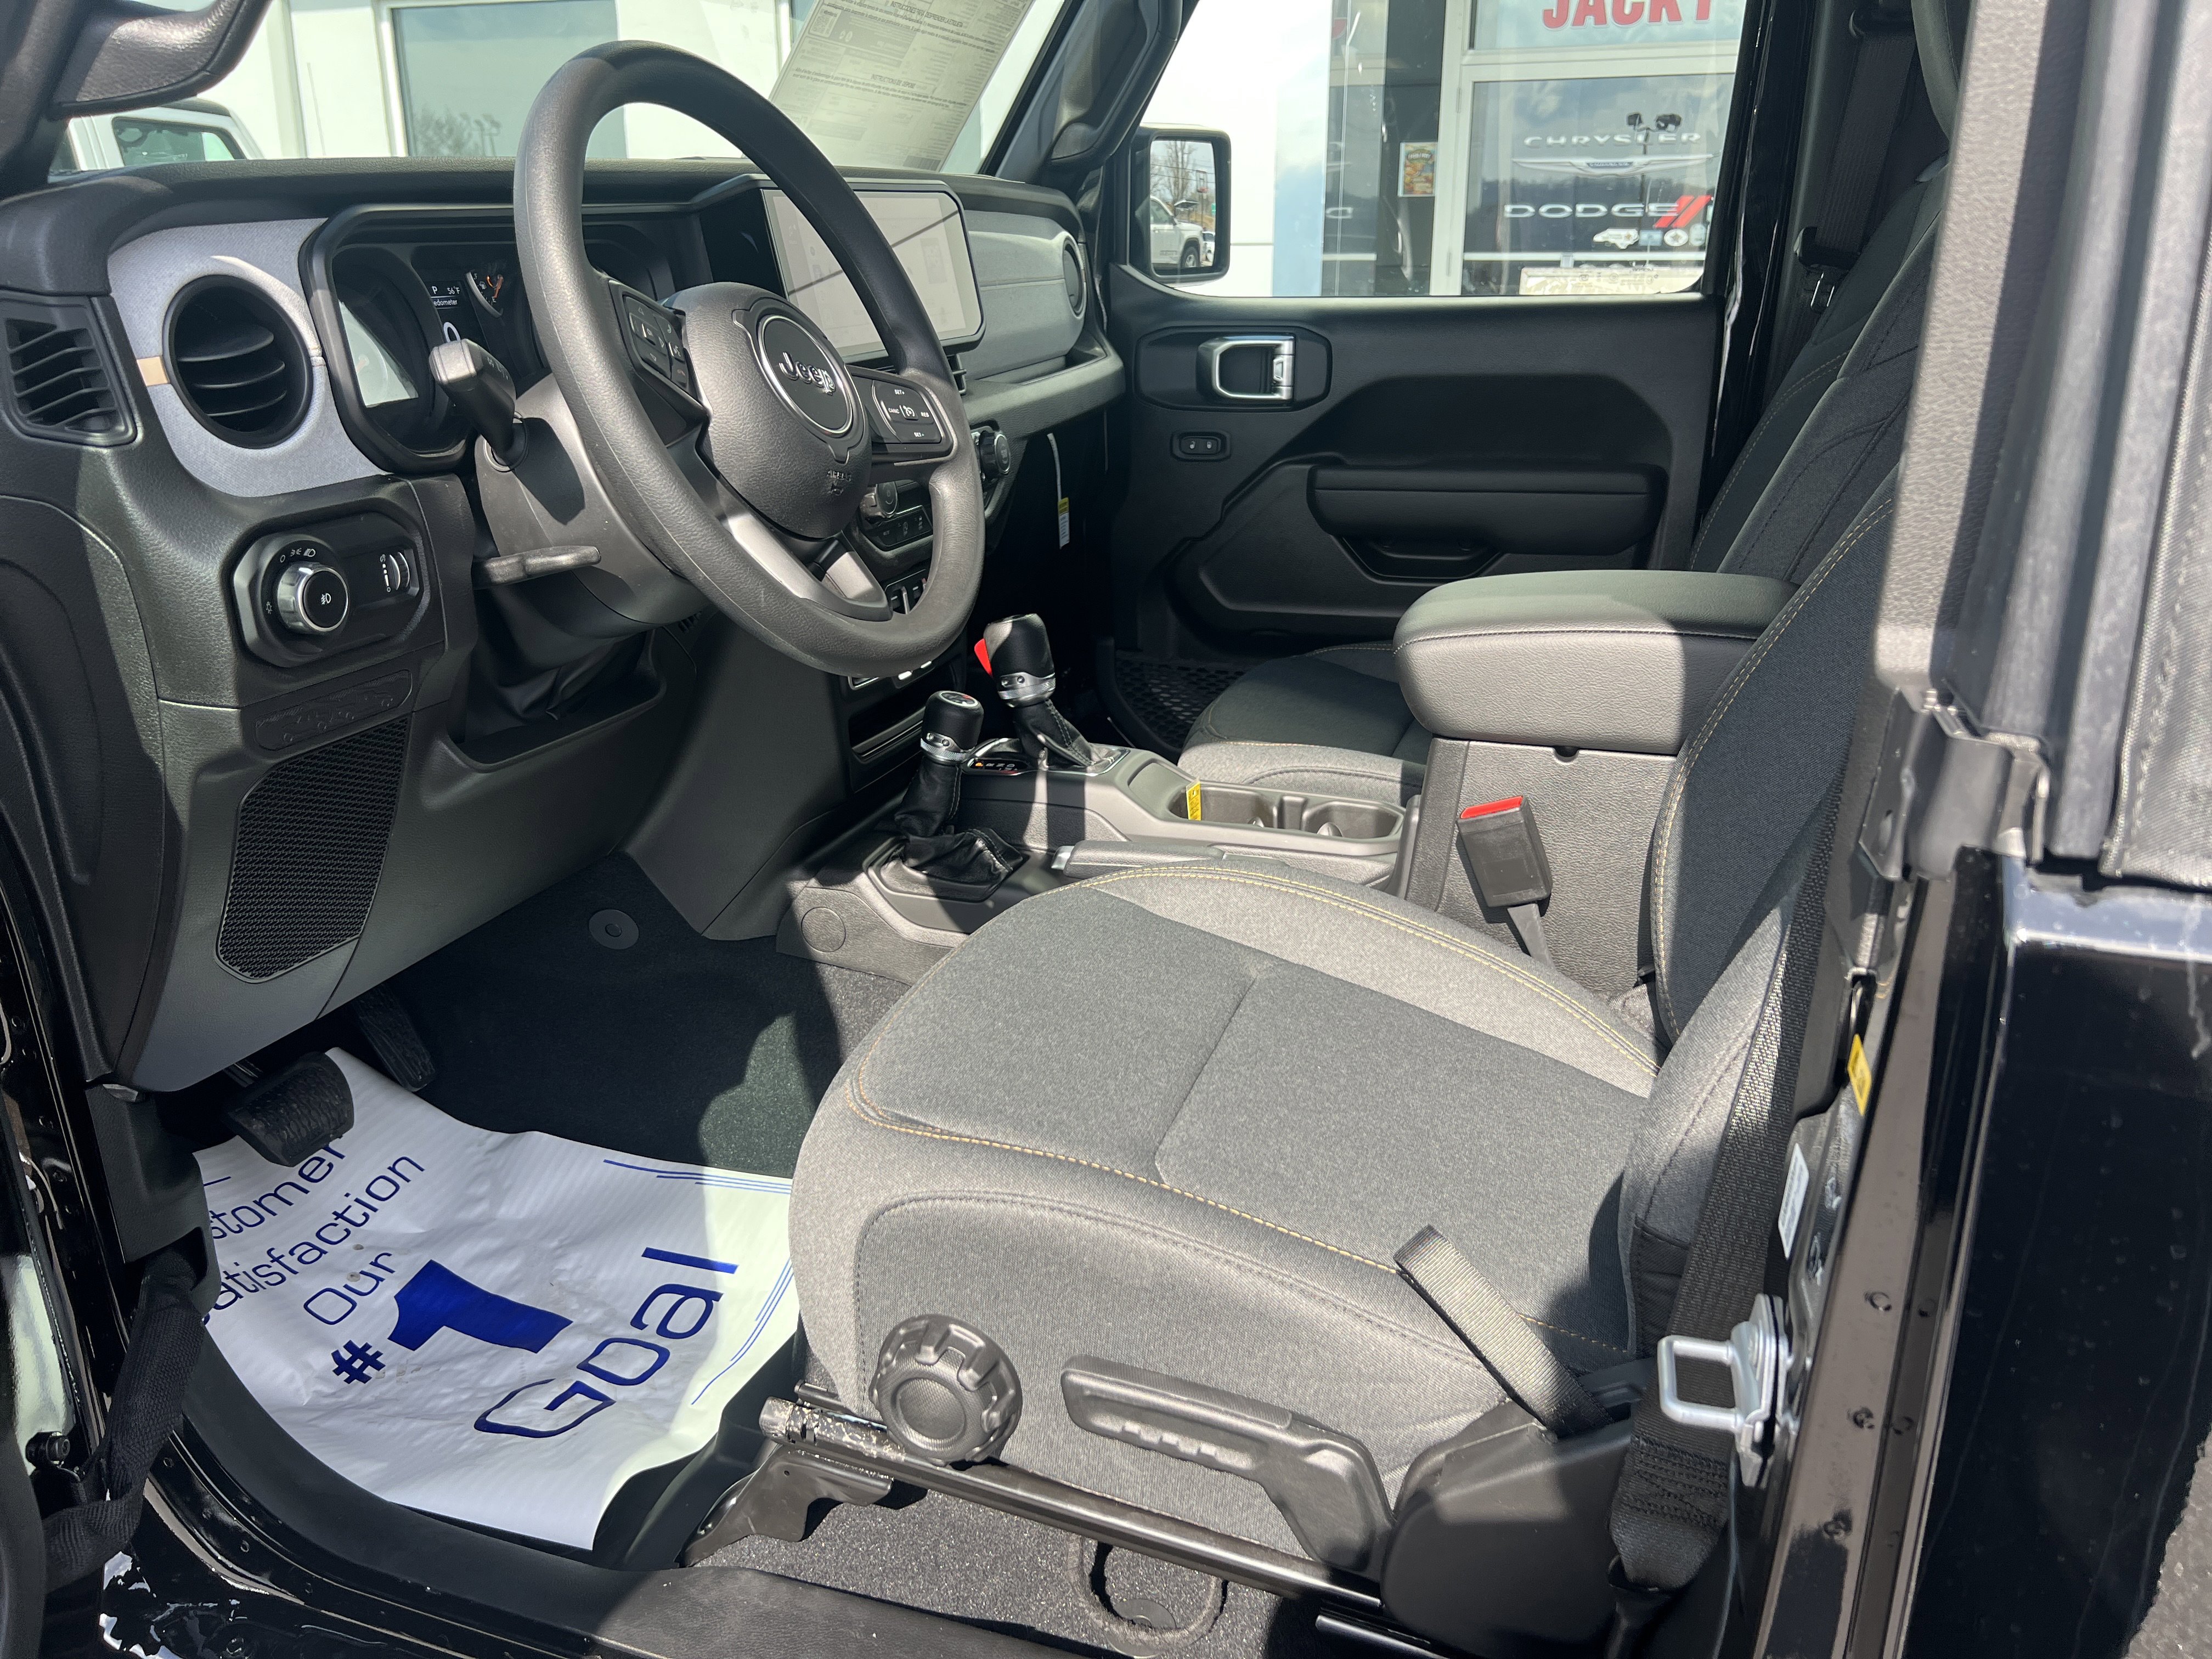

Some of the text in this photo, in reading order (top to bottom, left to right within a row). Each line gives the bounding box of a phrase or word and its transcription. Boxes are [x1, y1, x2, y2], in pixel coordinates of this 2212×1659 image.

[1524, 133, 1701, 145] CHRYSLER
[1504, 203, 1679, 218] DODGE
[432, 286, 438, 294] P
[779, 352, 835, 394] Jeep
[204, 1156, 425, 1325] atisfaction
[303, 1252, 396, 1325] Our
[474, 1247, 739, 1438] Goal
